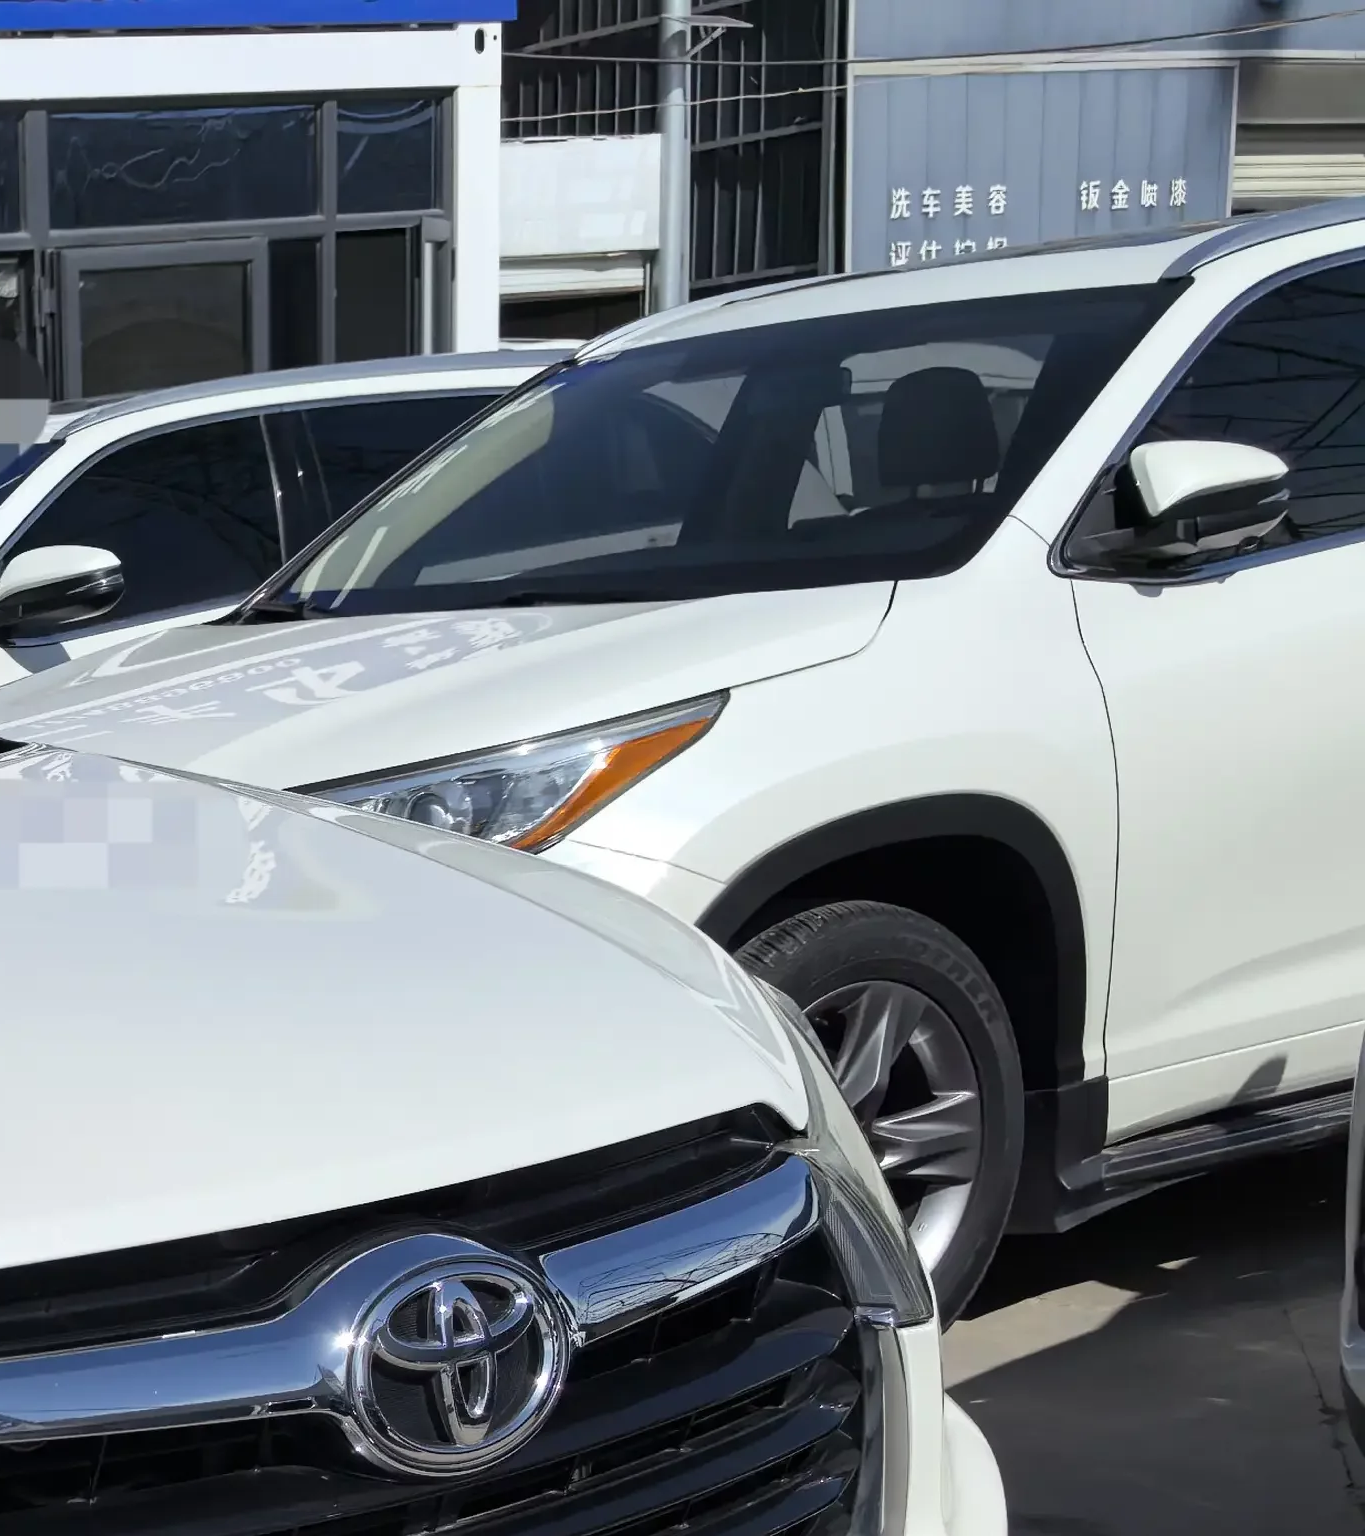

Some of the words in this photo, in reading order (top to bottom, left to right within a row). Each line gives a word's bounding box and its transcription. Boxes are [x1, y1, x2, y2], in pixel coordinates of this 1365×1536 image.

[889, 184, 1008, 219] 洗车美容
[1079, 179, 1187, 211] 钣金喷漆
